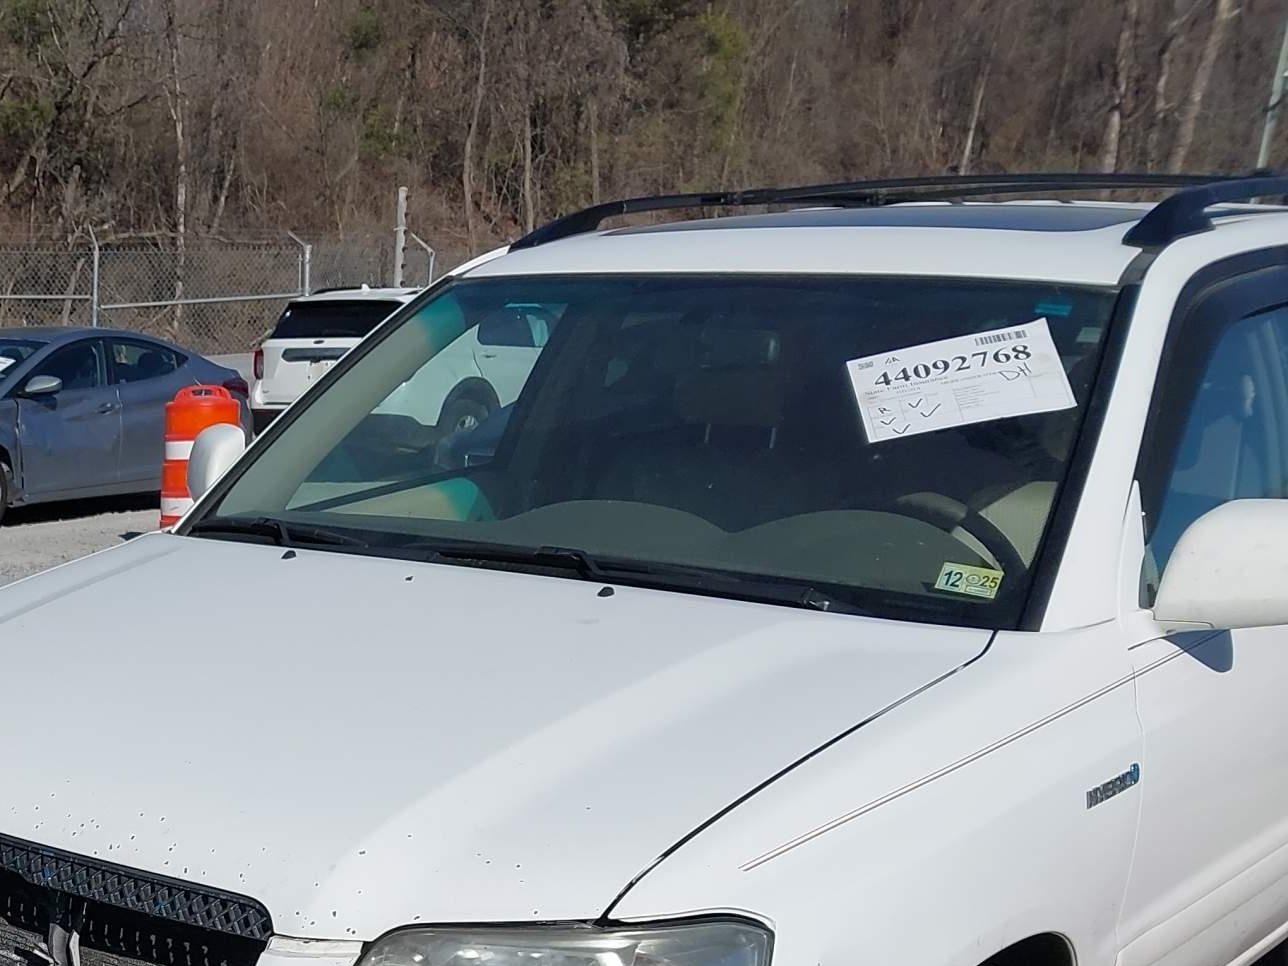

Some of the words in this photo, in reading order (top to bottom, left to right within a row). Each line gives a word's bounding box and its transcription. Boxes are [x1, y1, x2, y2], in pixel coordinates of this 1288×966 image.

[874, 344, 1032, 387] 44092768
[943, 570, 964, 588] 12
[980, 575, 1000, 589] 25
